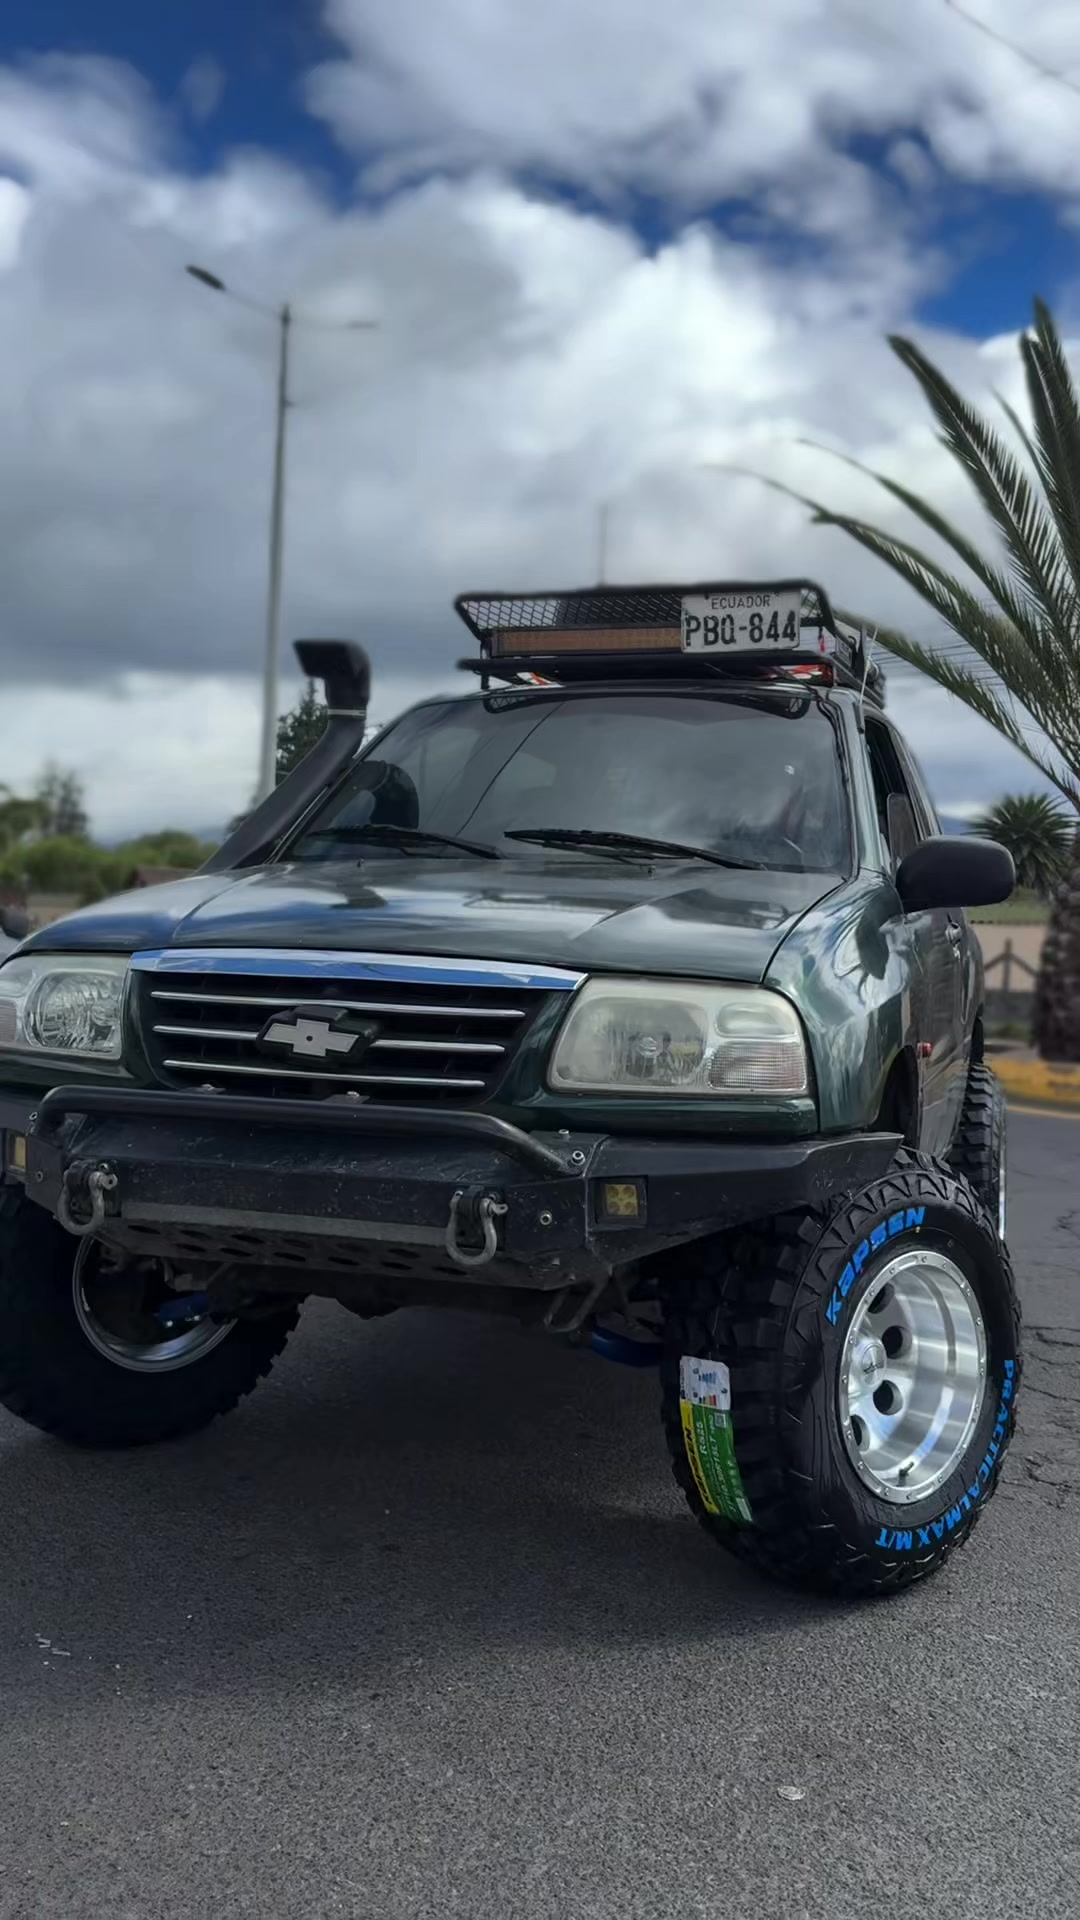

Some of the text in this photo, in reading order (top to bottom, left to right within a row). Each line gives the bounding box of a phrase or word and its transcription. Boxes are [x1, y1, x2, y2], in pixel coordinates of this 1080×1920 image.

[711, 595, 770, 610] ECUADOR
[685, 610, 796, 647] PBQ-844
[875, 1527, 913, 1549] M/T
